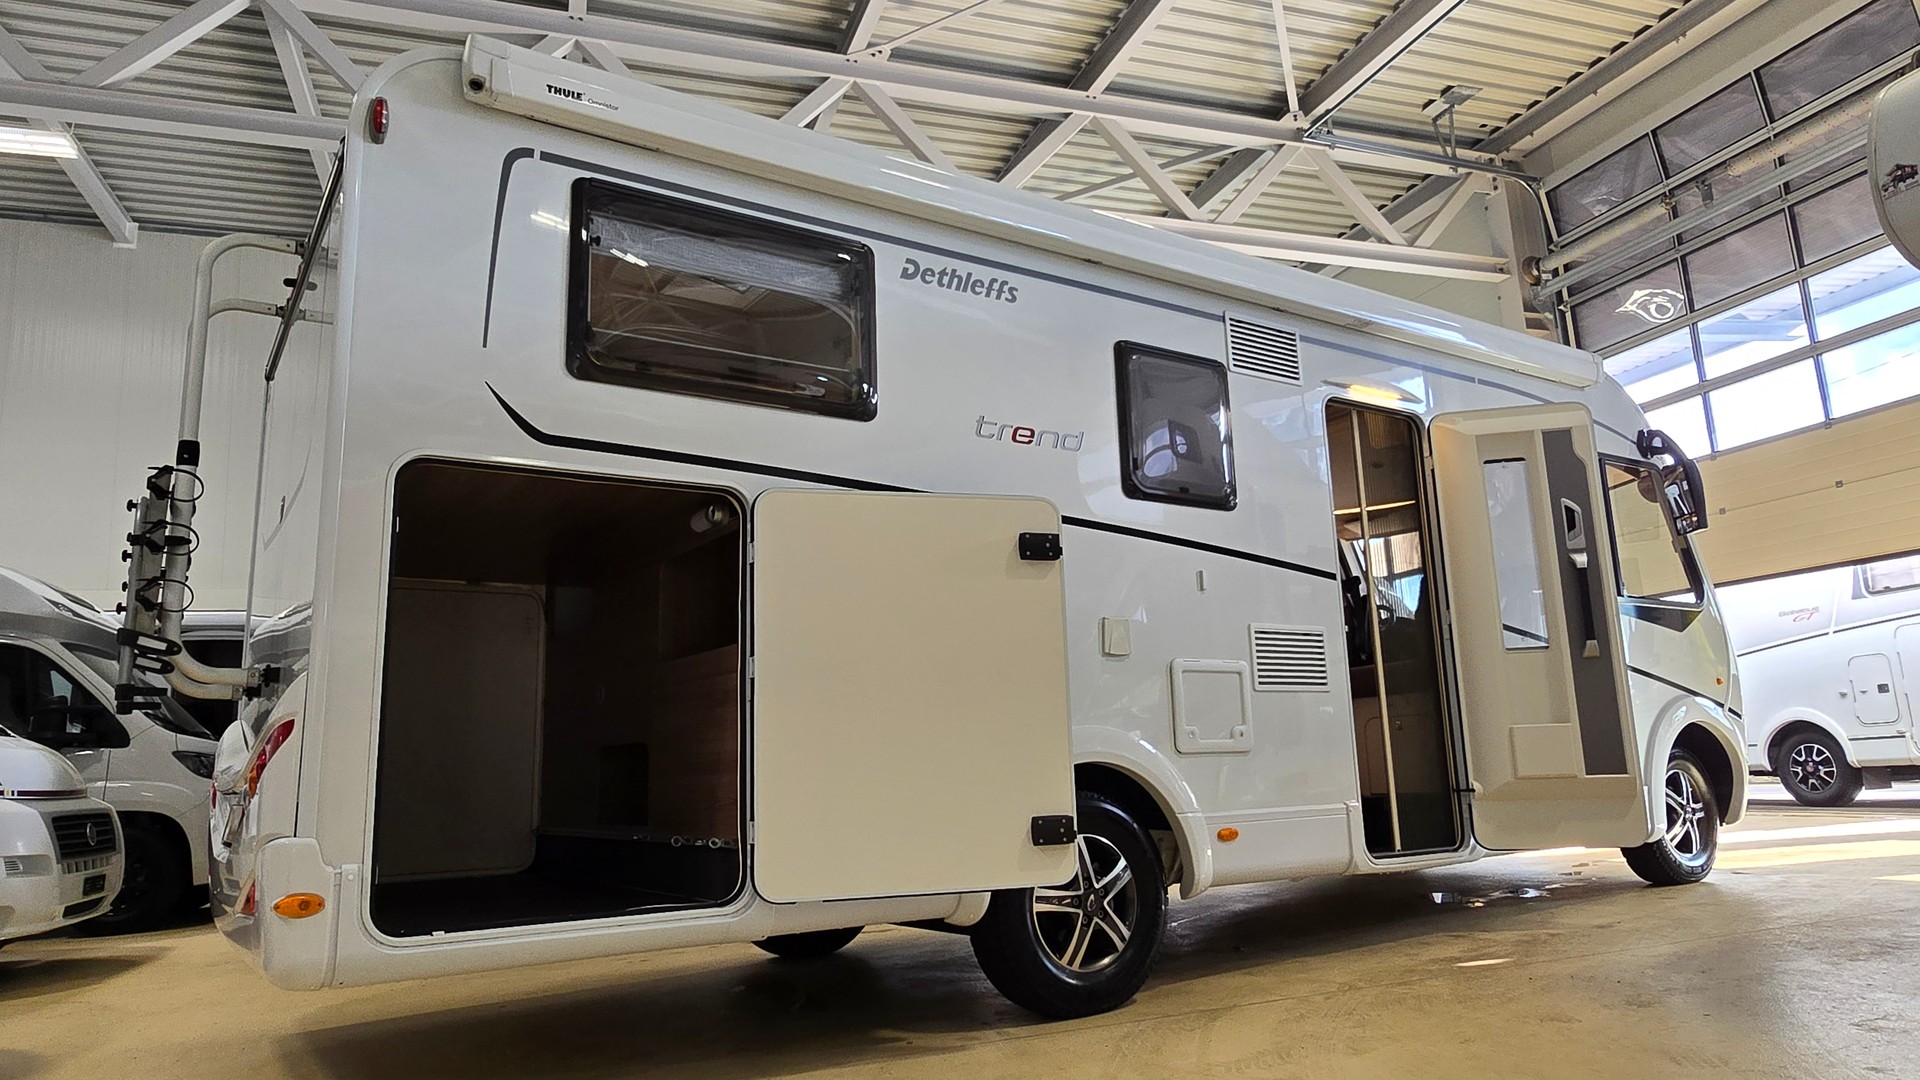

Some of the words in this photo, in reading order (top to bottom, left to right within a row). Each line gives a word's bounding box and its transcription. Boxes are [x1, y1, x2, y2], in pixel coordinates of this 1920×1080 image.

[546, 84, 583, 101] THULE
[900, 257, 1019, 303] Dethleffs
[975, 415, 1084, 452] trend
